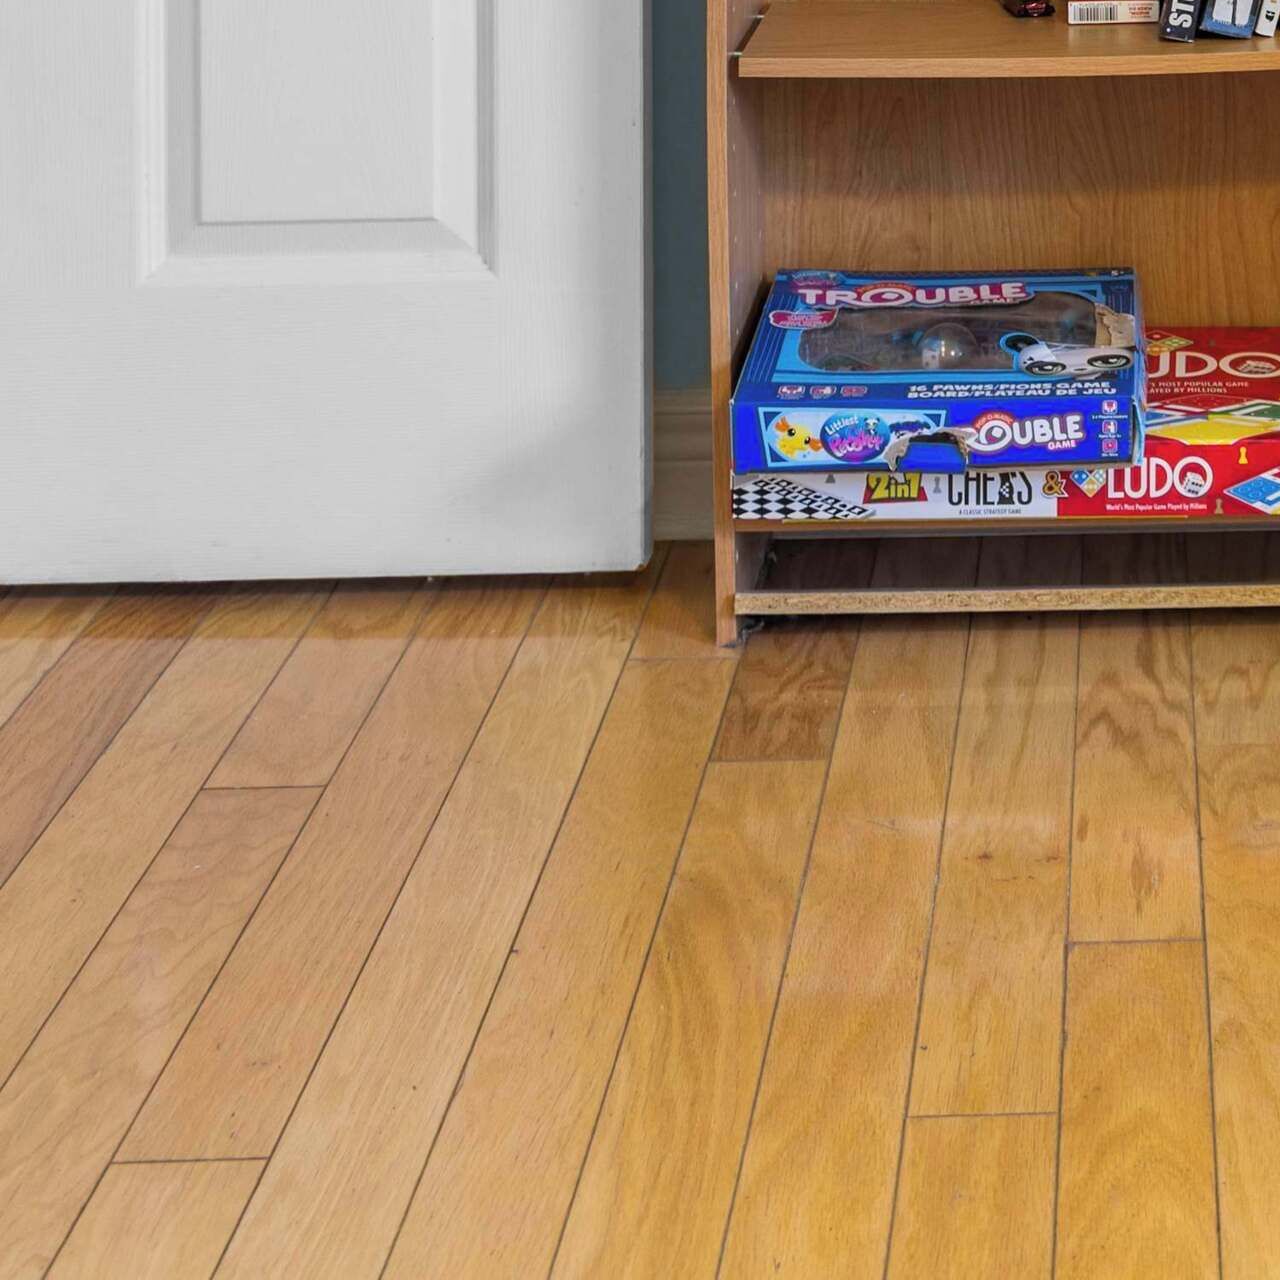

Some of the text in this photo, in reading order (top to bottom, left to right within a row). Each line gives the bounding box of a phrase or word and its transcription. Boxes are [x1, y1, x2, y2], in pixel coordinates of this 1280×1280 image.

[797, 282, 1026, 306] TROUBLE
[907, 389, 1050, 399] BOARD/PLATEAU
[1083, 387, 1117, 395] JEU
[1055, 381, 1111, 390] GAME
[824, 415, 860, 436] Littlest
[966, 415, 1083, 452] OUBLE
[1048, 440, 1077, 450] GAME
[1042, 471, 1065, 495] &
[1107, 456, 1214, 499] LUDO
